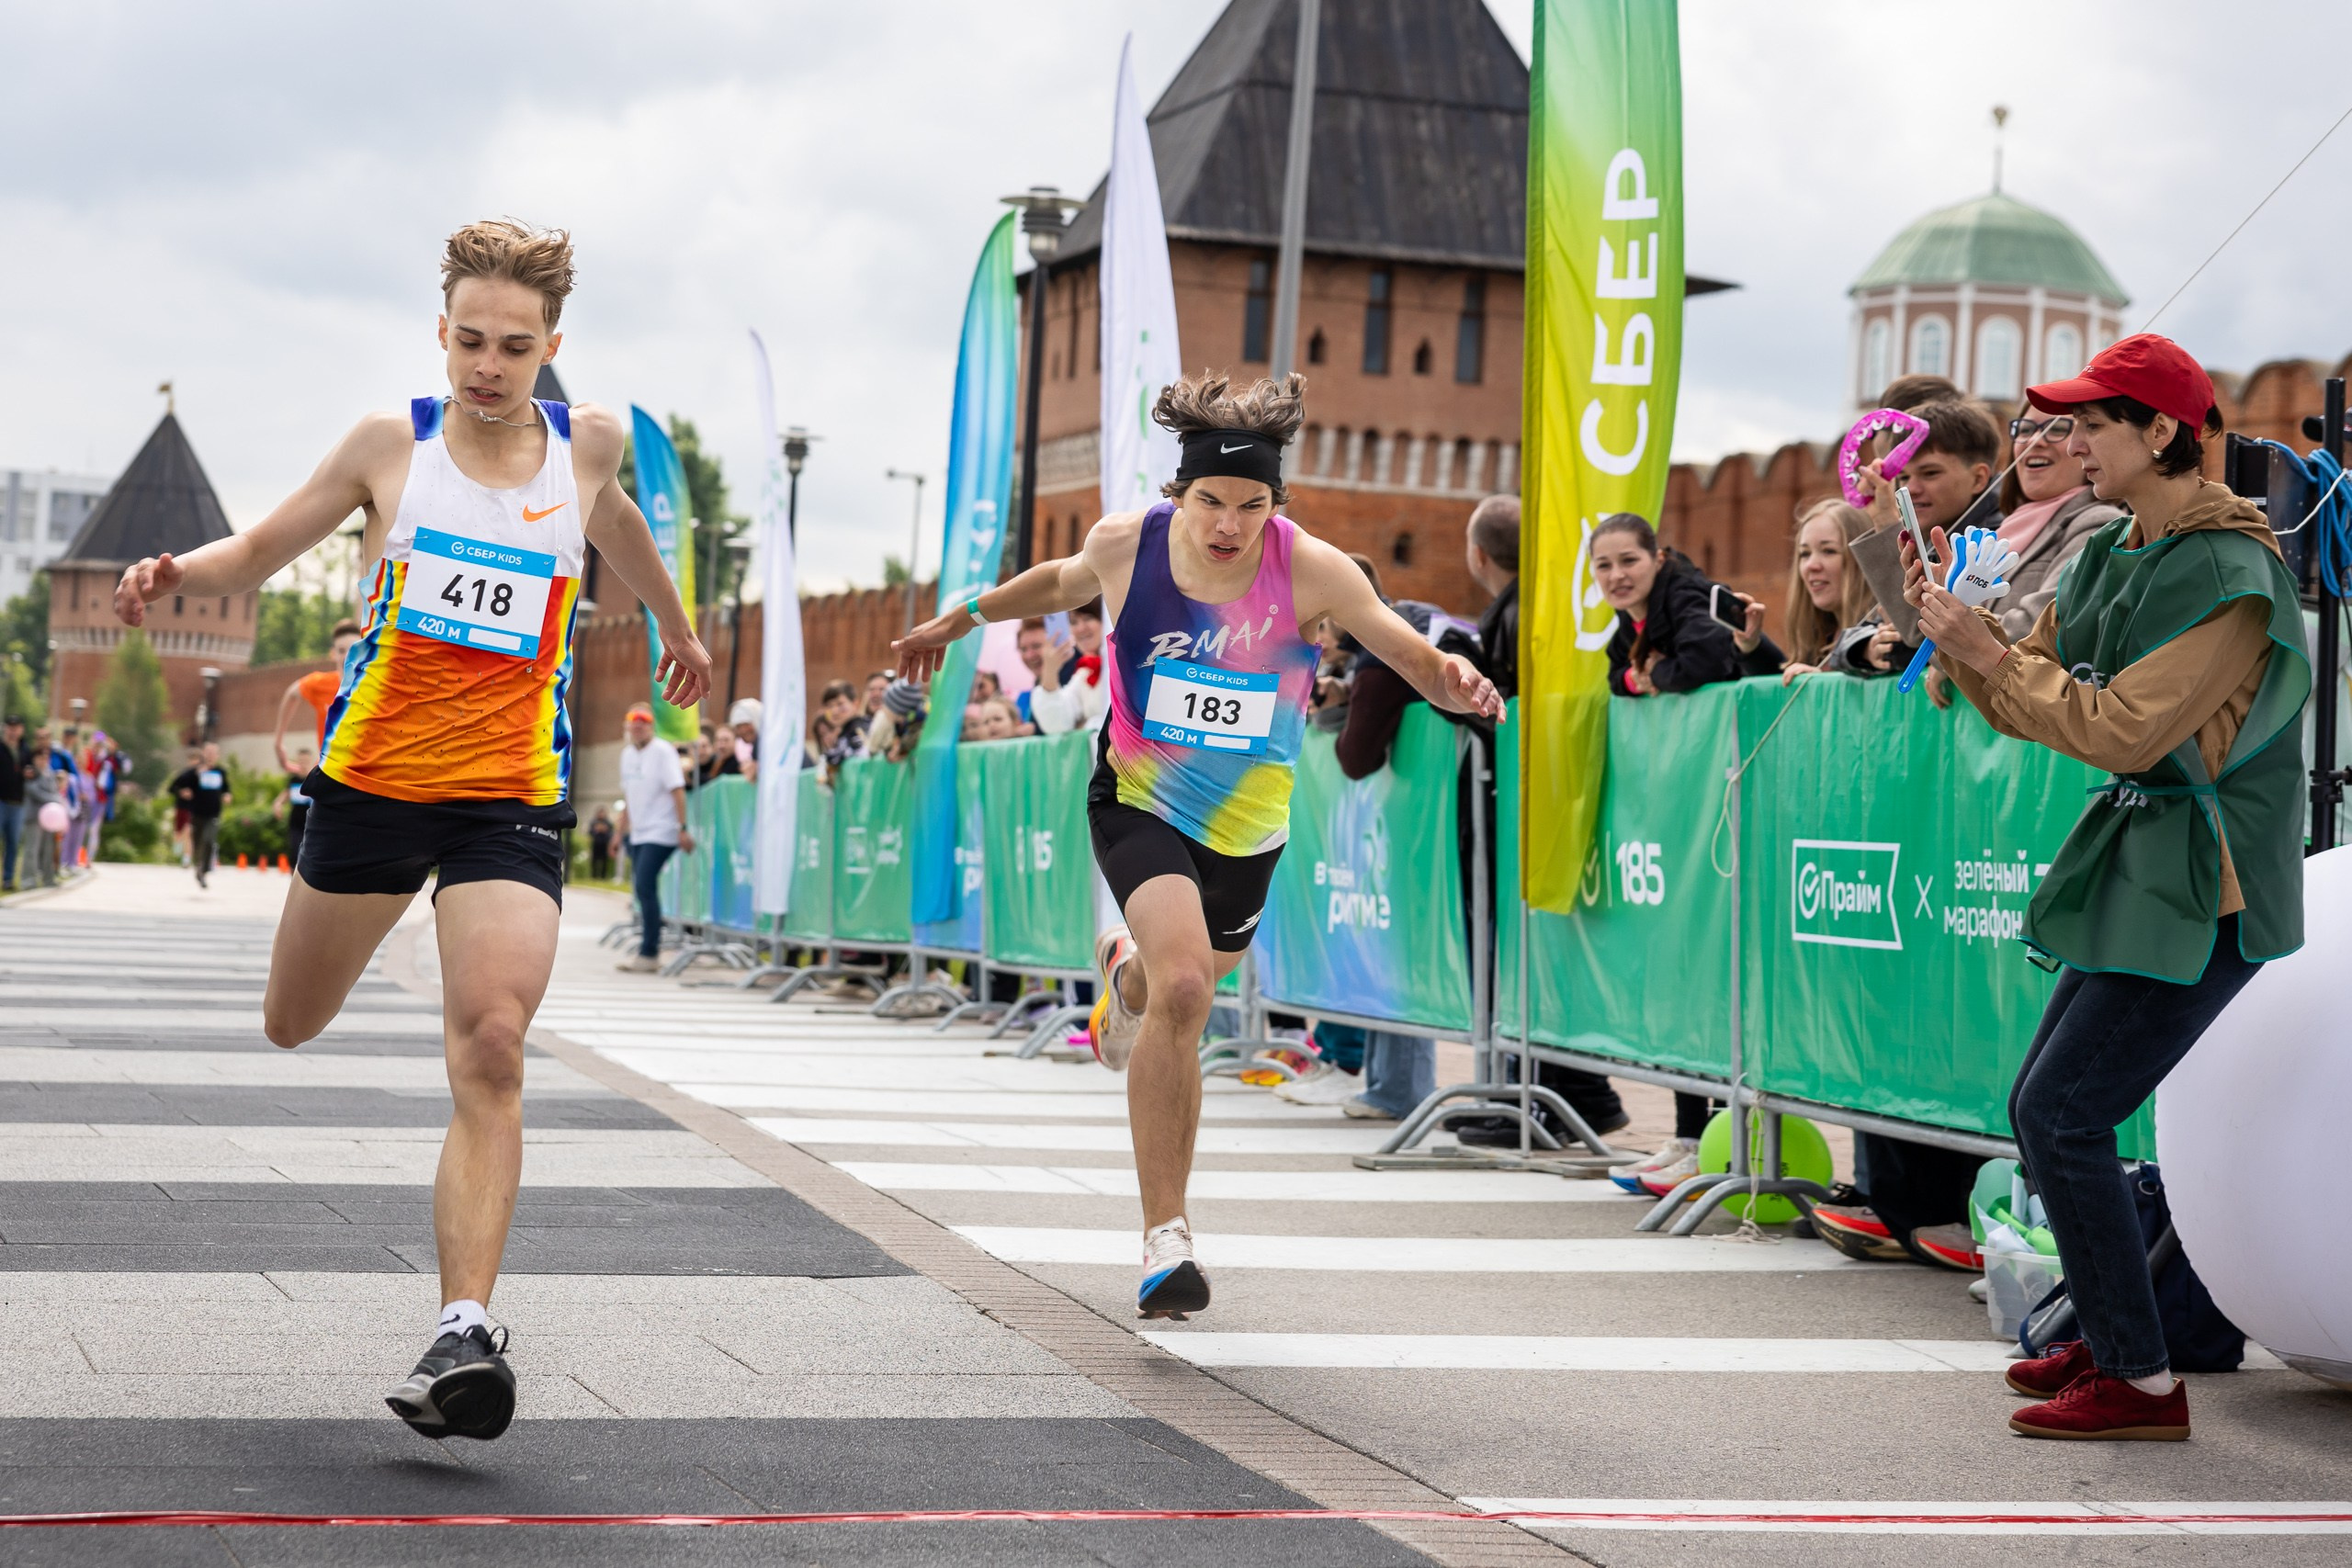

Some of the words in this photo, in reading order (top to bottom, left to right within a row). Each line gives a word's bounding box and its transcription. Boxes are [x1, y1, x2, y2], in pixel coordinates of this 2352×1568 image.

[1578, 147, 1659, 477] СБЕР
[467, 547, 496, 559] СБЕР
[498, 553, 523, 565] KIDS
[440, 573, 514, 617] 418
[1973, 578, 1989, 588] ПСБ
[417, 616, 446, 635] 420
[1199, 671, 1225, 682] СБЕР
[1227, 676, 1249, 686] KIDS
[1183, 692, 1242, 726] 183
[1160, 726, 1185, 742] 420
[1615, 840, 1666, 906] 185
[1954, 848, 2030, 894] зелёный
[1821, 870, 1882, 921] Прайм
[1943, 895, 2023, 949] марафон
